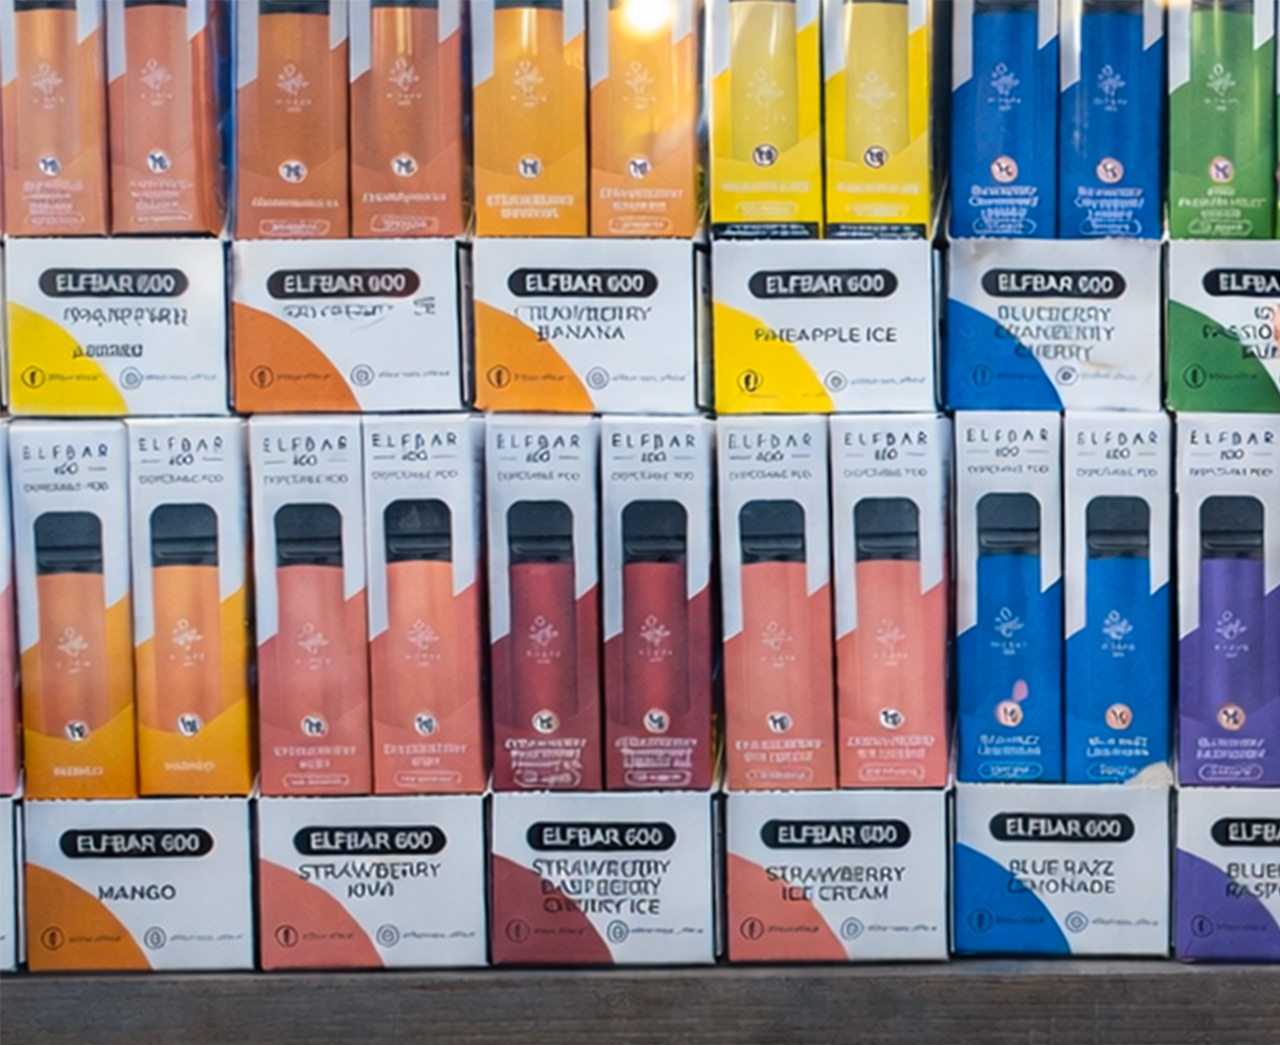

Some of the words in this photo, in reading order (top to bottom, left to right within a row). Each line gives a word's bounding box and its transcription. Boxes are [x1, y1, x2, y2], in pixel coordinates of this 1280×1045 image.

[766, 275, 842, 293] ELFBAR
[847, 275, 885, 292] 600
[998, 273, 1073, 292] ELFBAR
[1078, 274, 1114, 293] 600
[866, 327, 897, 342] ICE
[542, 828, 621, 846] ELFBAR
[625, 827, 663, 846] 600
[777, 826, 856, 843] ELFBAR
[1006, 819, 1083, 838] ELFBAR
[1085, 819, 1122, 837] 600
[76, 834, 155, 852] ELFBAR
[162, 833, 200, 852] 600
[310, 831, 390, 849] ELFBAR
[98, 884, 176, 900] MANGO
[630, 898, 660, 915] ICE
